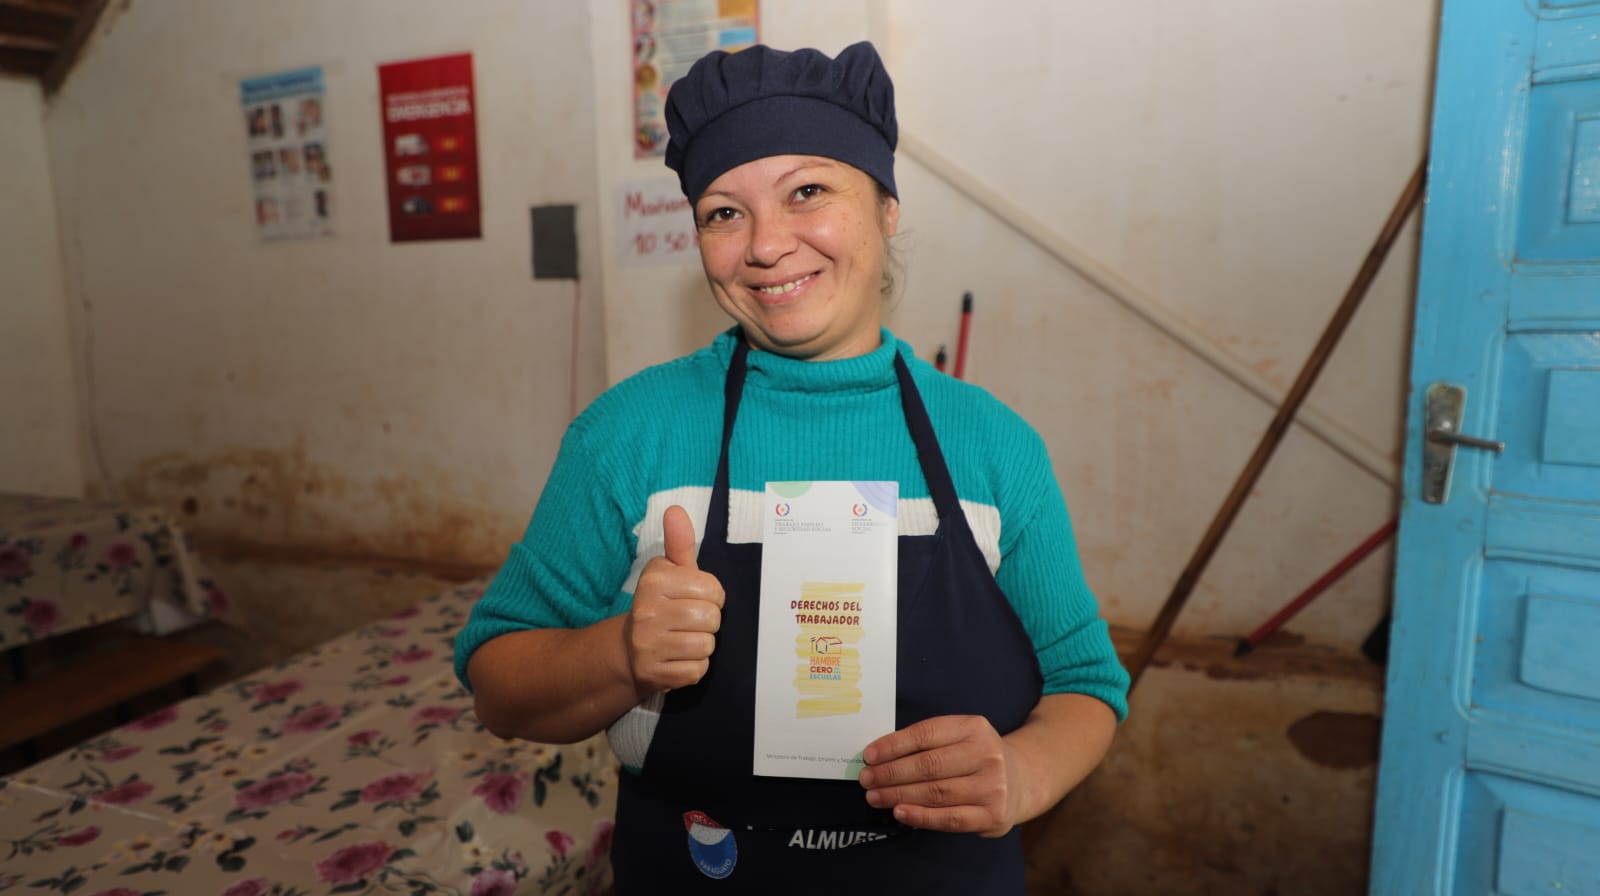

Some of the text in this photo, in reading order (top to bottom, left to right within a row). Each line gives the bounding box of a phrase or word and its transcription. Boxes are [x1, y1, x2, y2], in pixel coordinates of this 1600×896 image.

[790, 600, 862, 611] DERECHOS DEL
[795, 614, 860, 625] TRABAJADOR
[810, 656, 841, 666] HAMBRE
[810, 665, 833, 673] CERO
